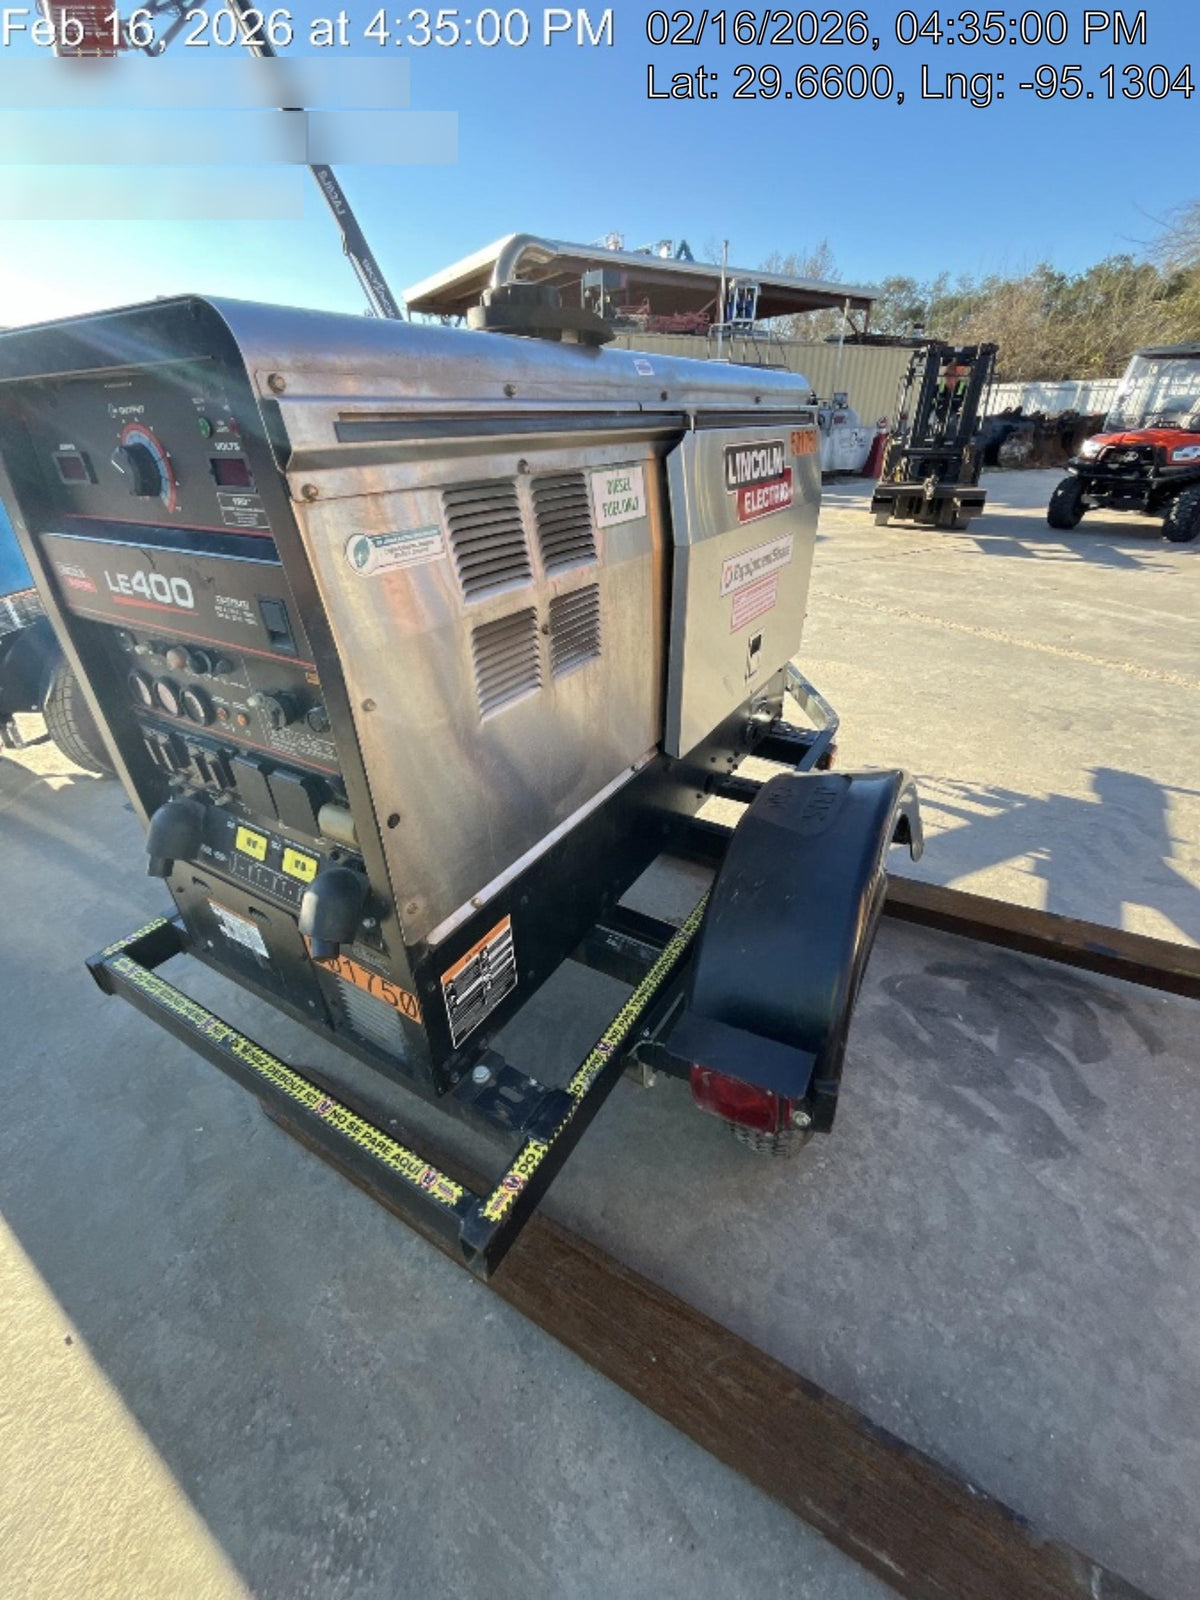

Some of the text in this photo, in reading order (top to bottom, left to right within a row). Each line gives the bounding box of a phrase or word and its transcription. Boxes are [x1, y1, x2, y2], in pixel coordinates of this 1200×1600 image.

[728, 446, 783, 485] LINCOLN
[744, 482, 789, 514] ELECTRIC
[104, 570, 195, 609] LE400
[329, 1108, 348, 1124] NO
[345, 1120, 363, 1136] SE
[362, 1130, 394, 1157] PARE
[518, 1152, 537, 1175] DO
